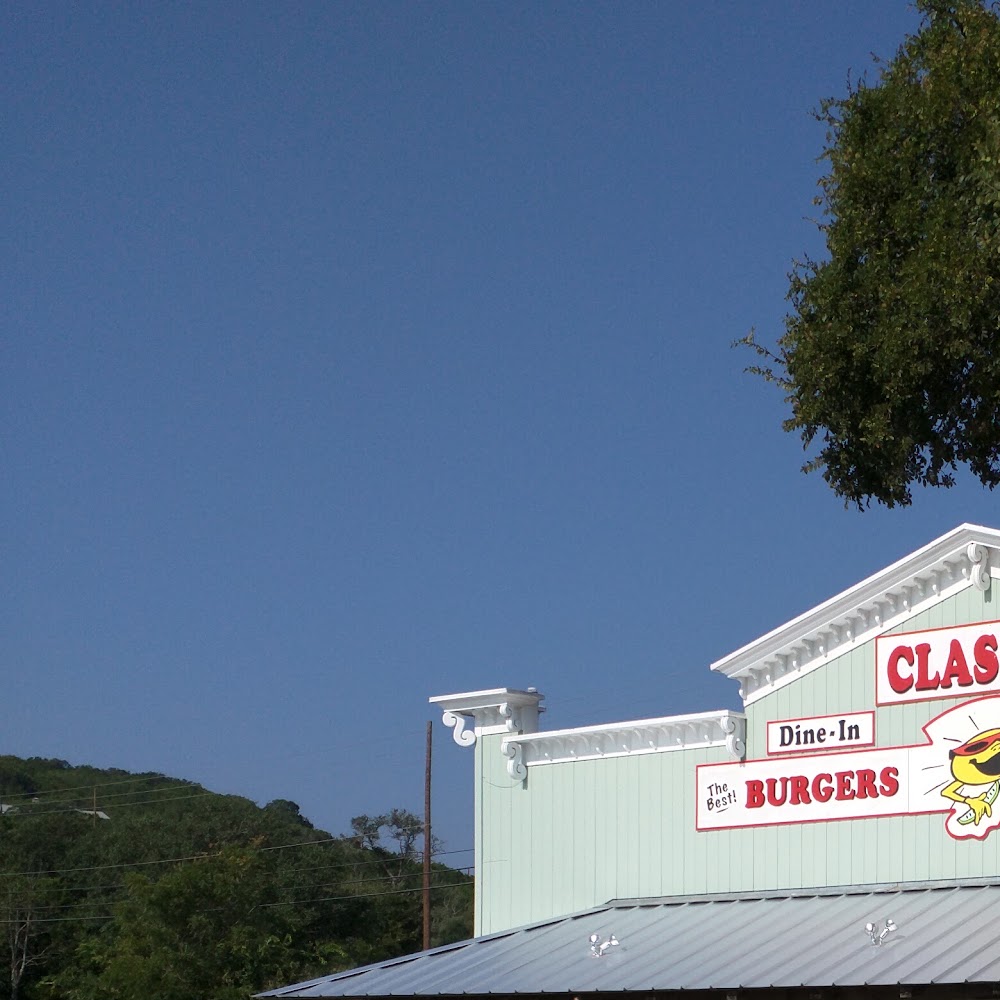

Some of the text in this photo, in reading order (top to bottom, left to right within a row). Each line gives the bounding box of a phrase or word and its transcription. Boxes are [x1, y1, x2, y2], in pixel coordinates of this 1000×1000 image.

[779, 720, 860, 747] Dine-In
[707, 782, 728, 797] The
[745, 766, 900, 808] BURGERS
[706, 790, 737, 811] Best!
